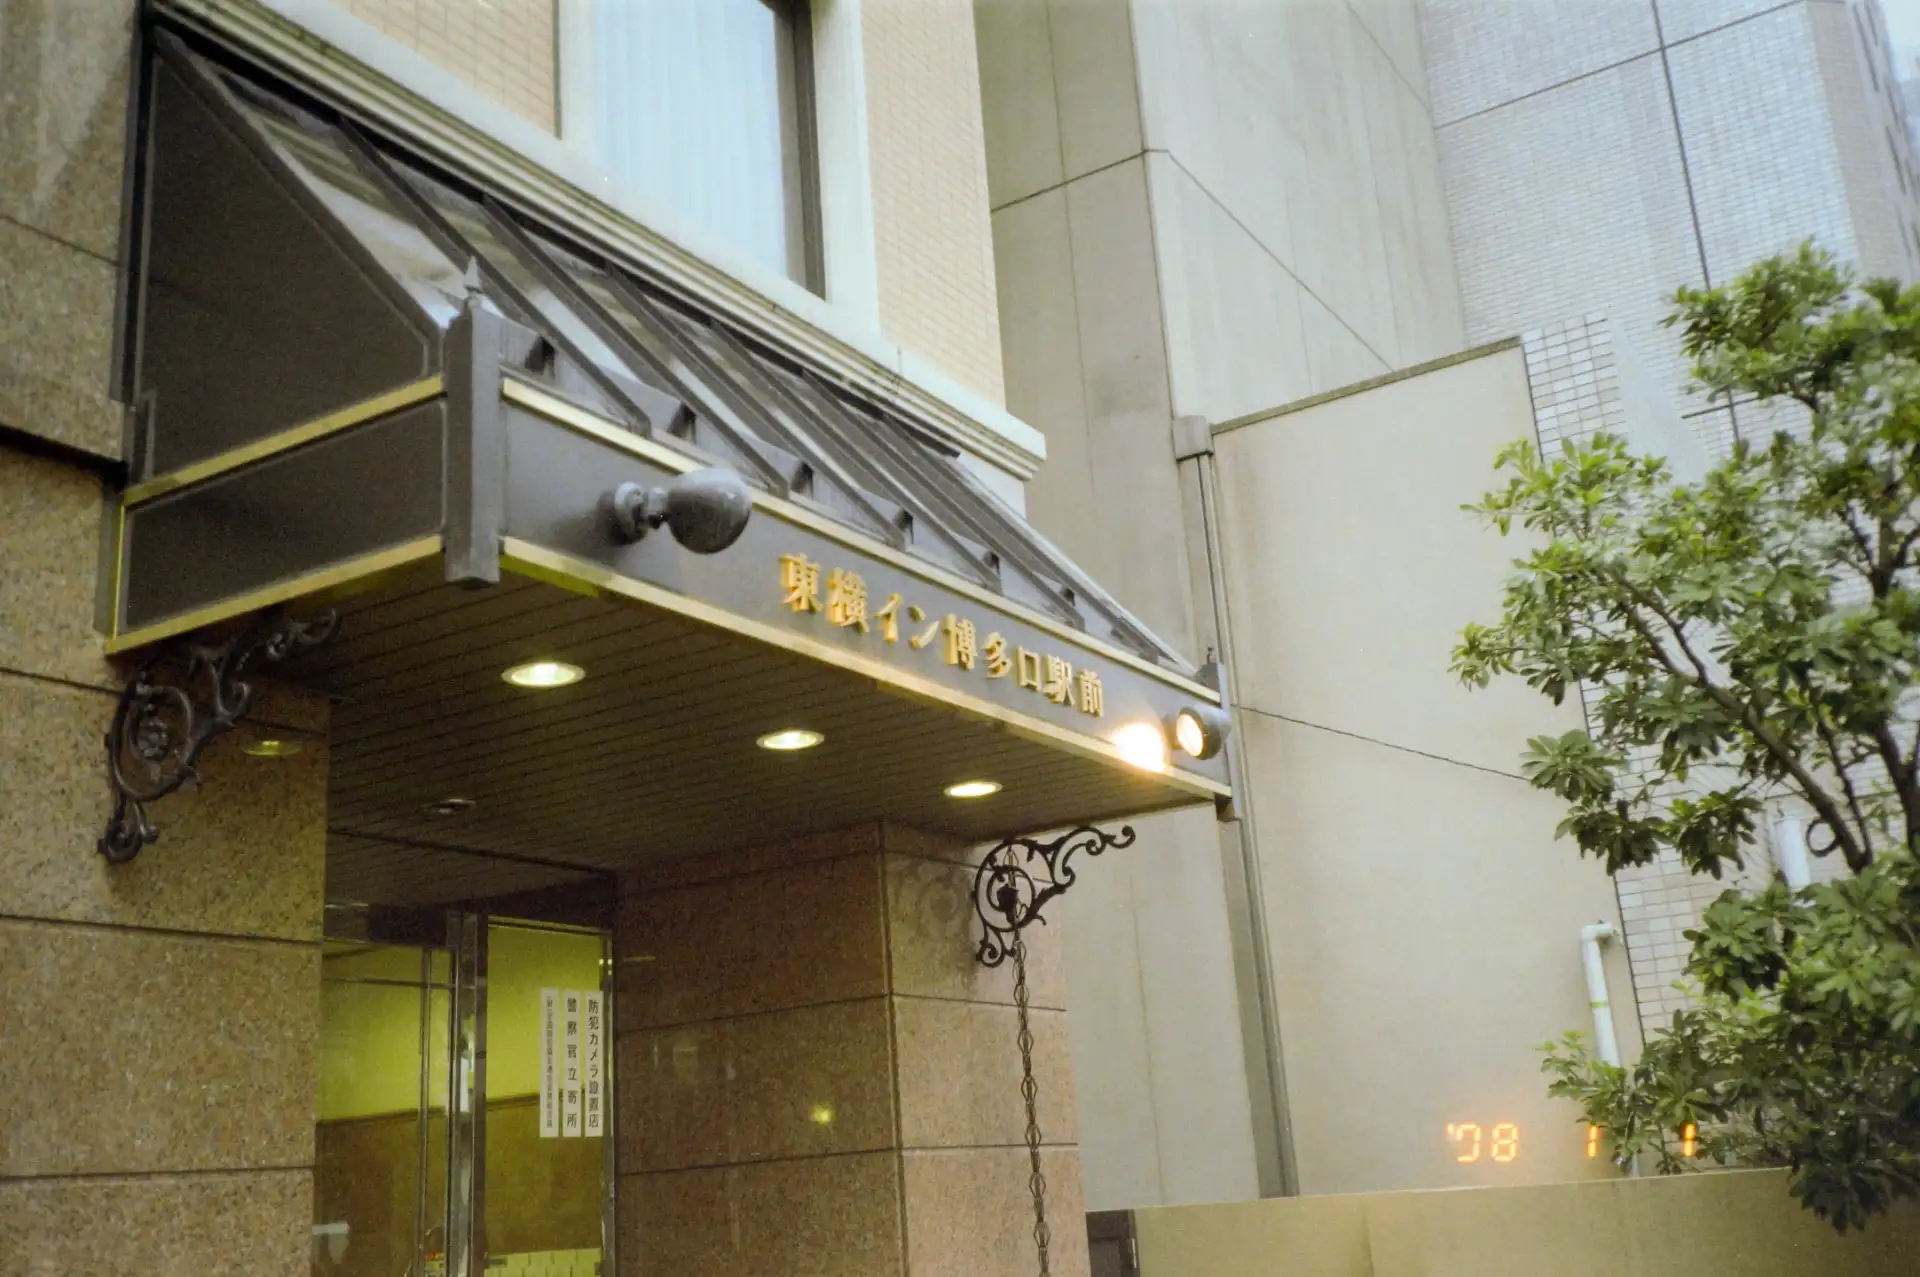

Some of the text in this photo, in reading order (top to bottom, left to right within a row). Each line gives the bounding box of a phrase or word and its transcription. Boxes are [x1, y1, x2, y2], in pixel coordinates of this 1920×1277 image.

[779, 552, 1104, 717] 東横イン博多口駅前
